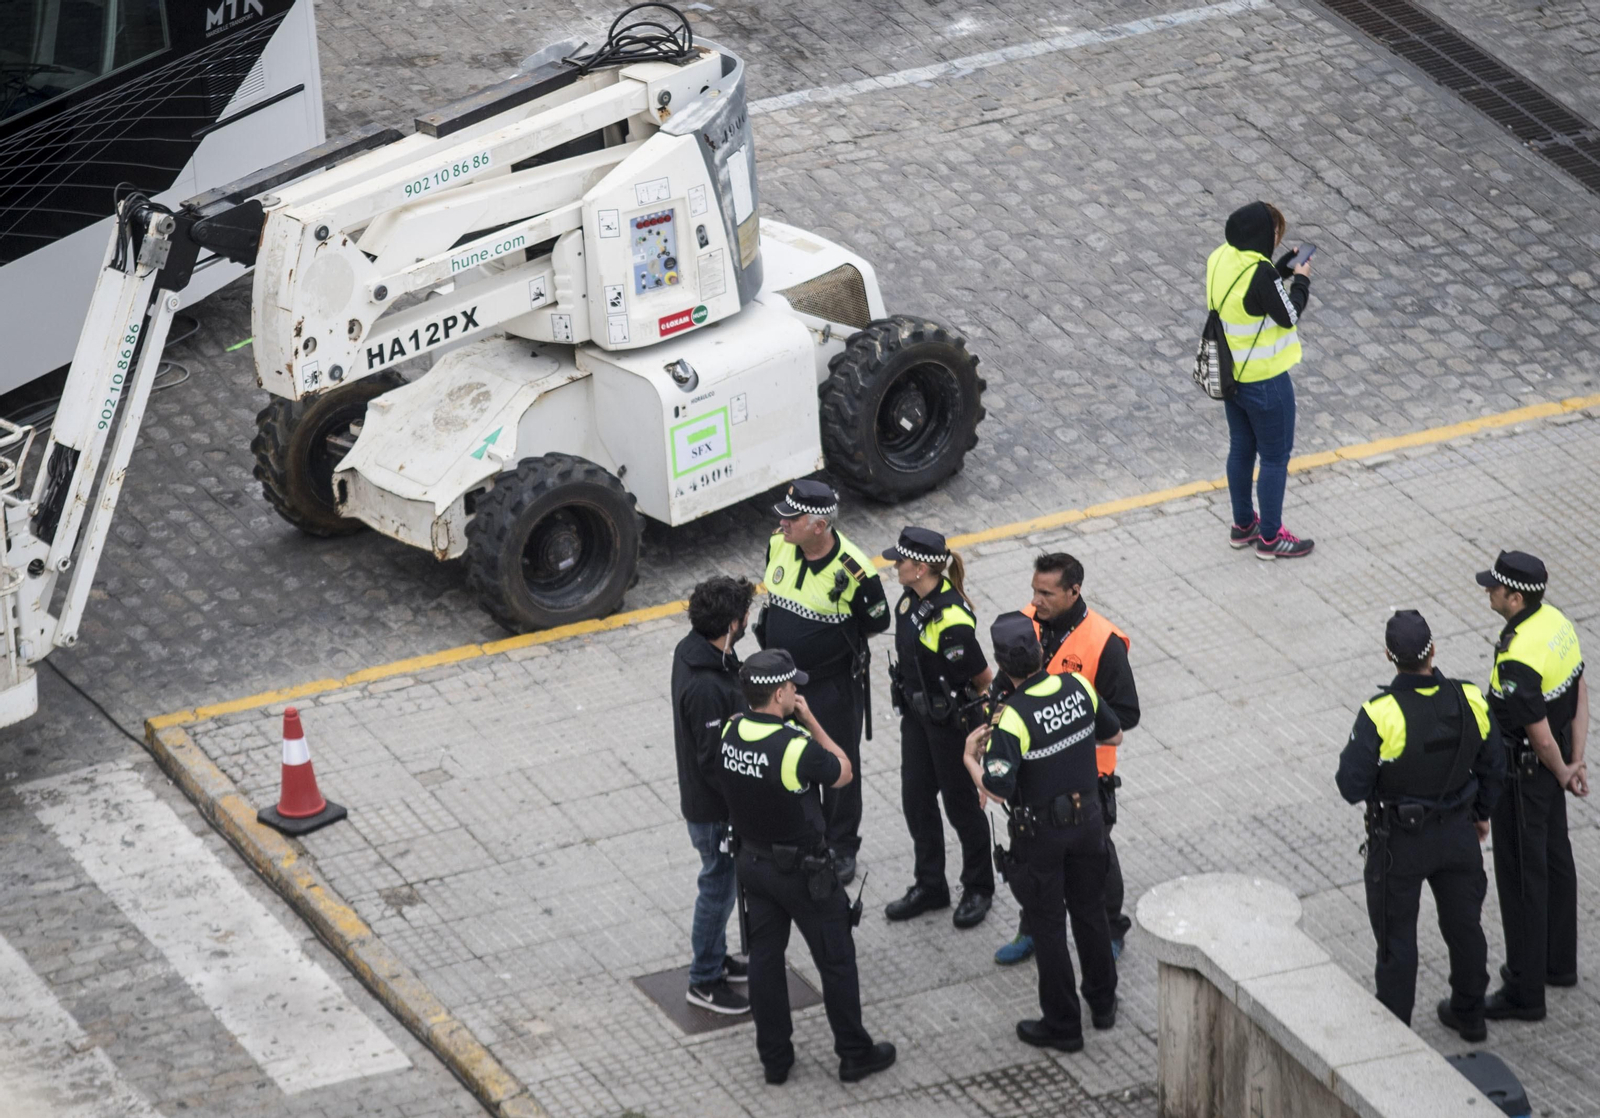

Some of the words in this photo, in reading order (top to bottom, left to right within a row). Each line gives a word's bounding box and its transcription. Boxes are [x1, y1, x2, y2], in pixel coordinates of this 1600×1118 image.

[229, 12, 254, 28] TRANSPORT
[404, 177, 431, 198] 902
[433, 169, 450, 186] 10
[452, 160, 470, 178] 86
[472, 152, 490, 169] 86
[450, 234, 526, 273] hune.com
[366, 305, 480, 370] HA12PX
[97, 398, 117, 430] 902
[109, 373, 124, 394] 10
[117, 349, 132, 371] 86
[125, 323, 140, 345] 86
[691, 441, 713, 459] SFX
[1033, 690, 1086, 724] POLICIA
[1043, 704, 1087, 734] LOCAL
[721, 742, 769, 767] POLICIA
[724, 756, 763, 779] LOCAL
